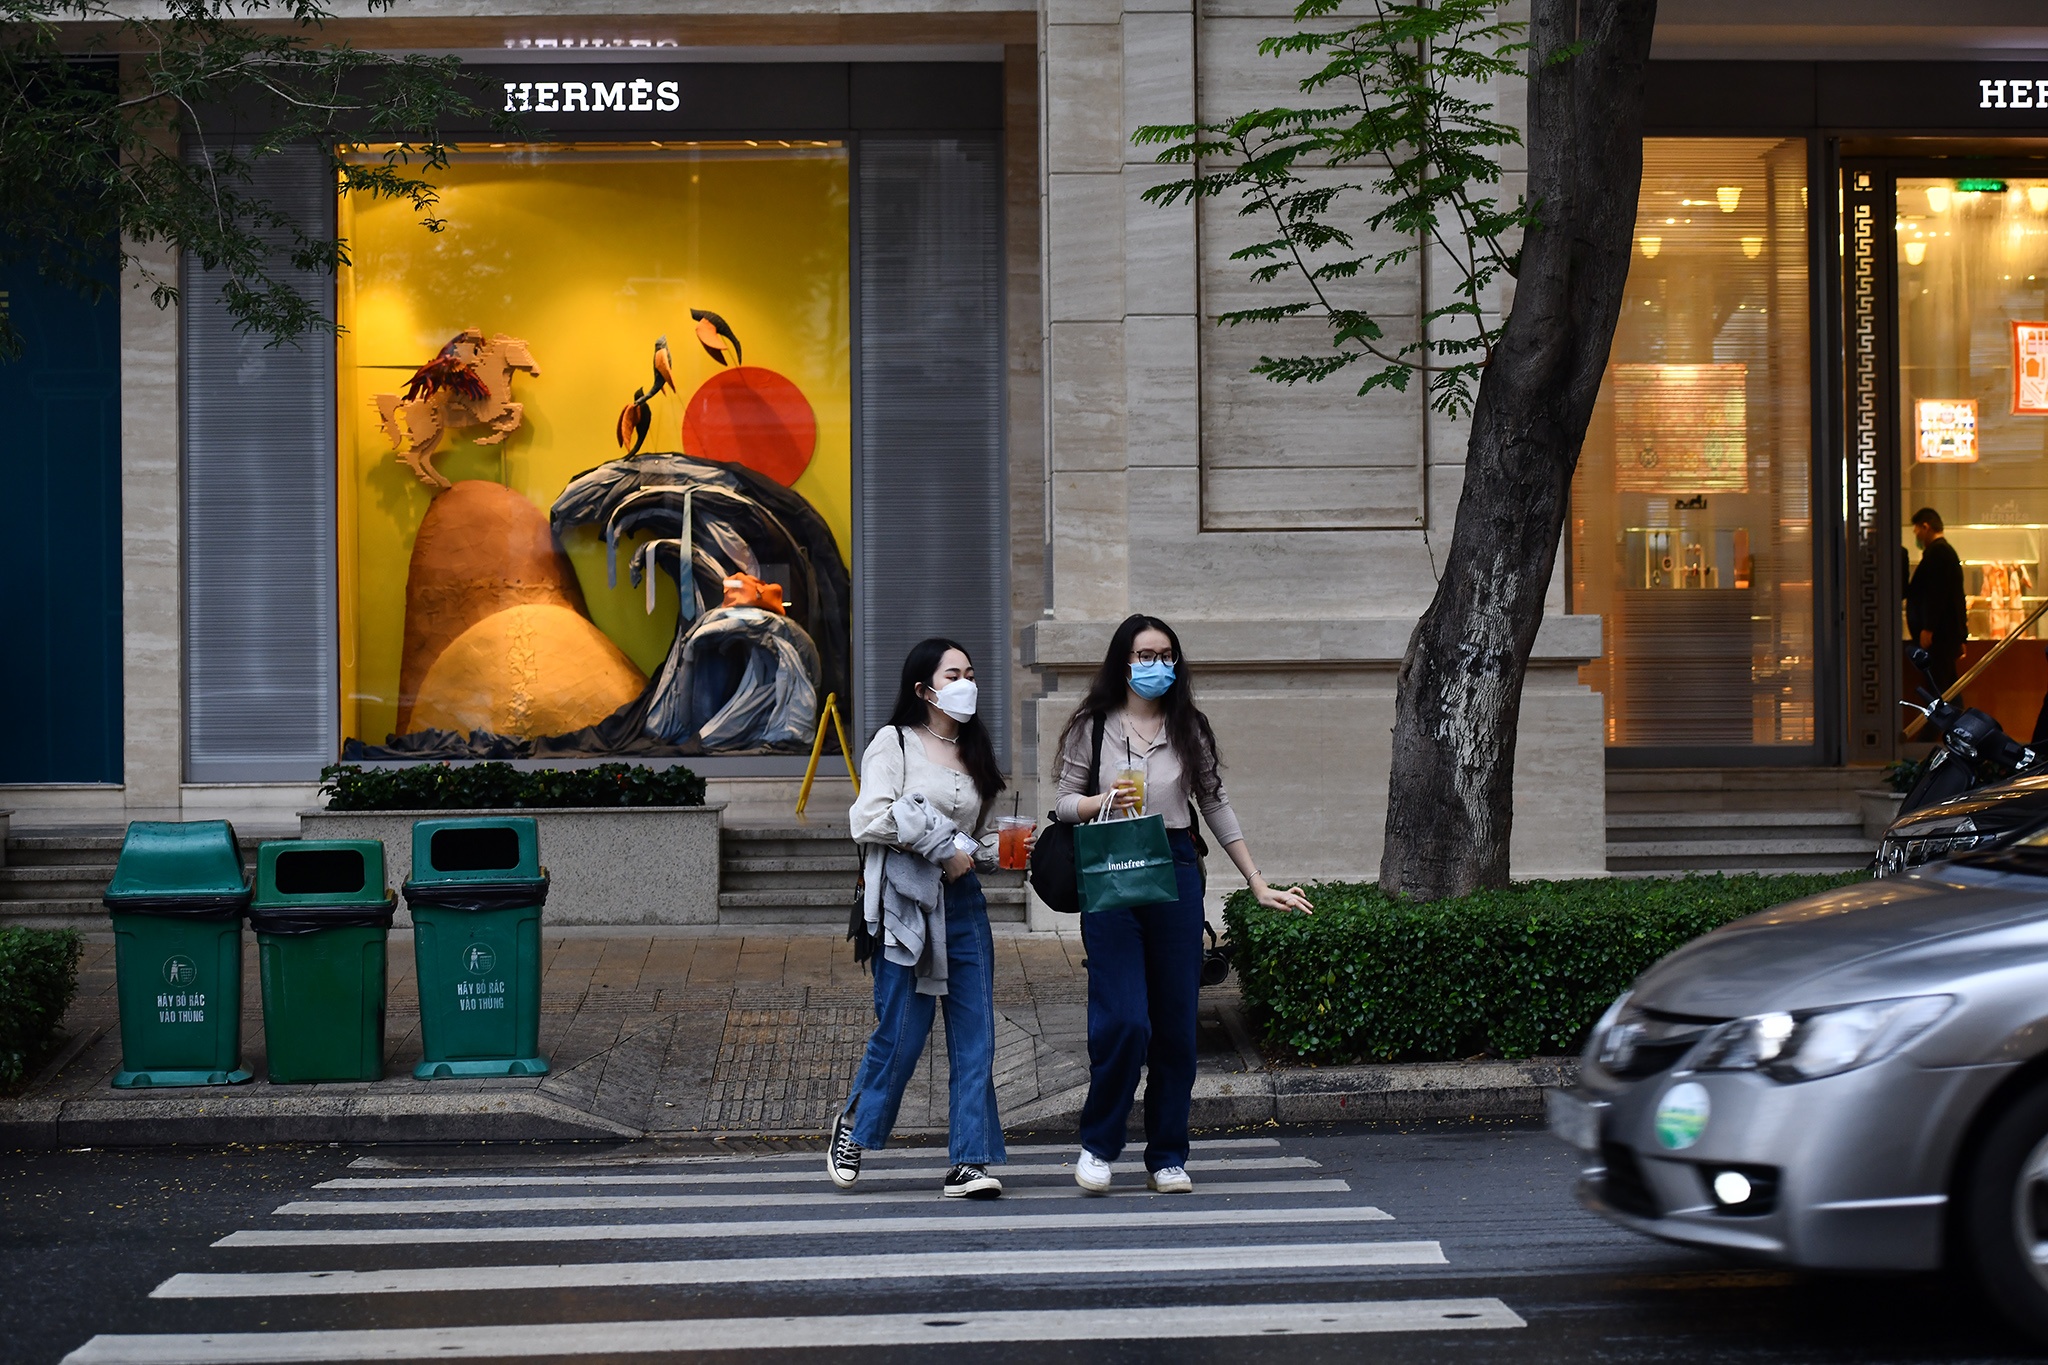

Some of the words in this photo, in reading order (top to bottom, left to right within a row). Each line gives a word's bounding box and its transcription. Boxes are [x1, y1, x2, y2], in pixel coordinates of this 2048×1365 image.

[504, 79, 680, 112] HERMÈS
[1108, 859, 1146, 871] innisfree
[457, 981, 473, 996] HÃY
[475, 979, 487, 995] BỎ
[488, 979, 505, 994] RÁC
[157, 992, 174, 1008] HÃY
[176, 991, 187, 1007] BỎ
[189, 992, 205, 1007] RÁC
